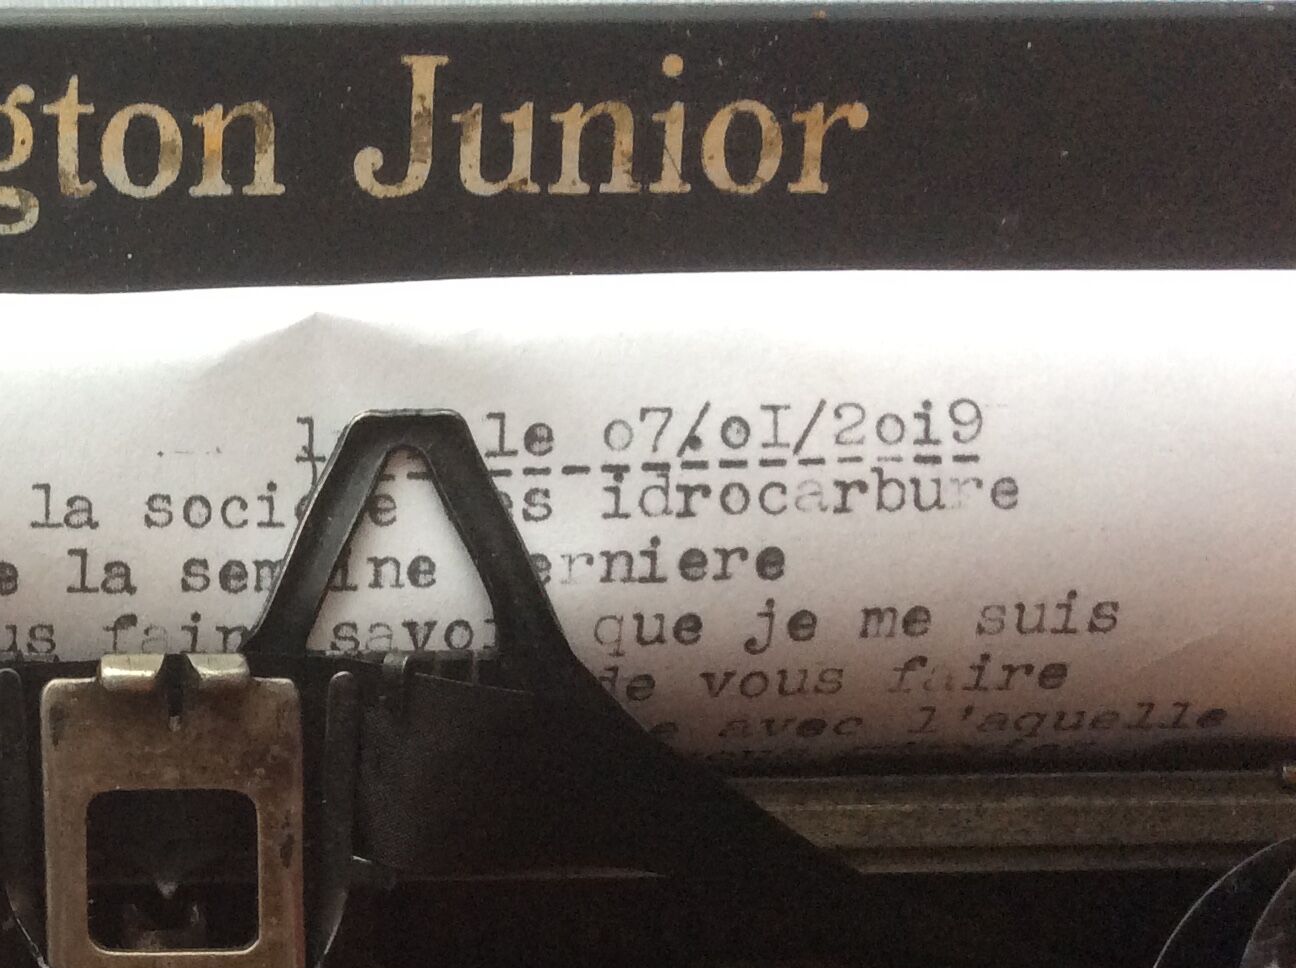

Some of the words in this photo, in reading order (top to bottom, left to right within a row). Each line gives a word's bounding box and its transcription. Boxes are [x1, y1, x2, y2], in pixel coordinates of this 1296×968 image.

[352, 52, 870, 198] Junior
[485, 410, 556, 459] le
[29, 481, 100, 531] la
[600, 466, 1020, 518] idrocarbure
[65, 547, 138, 597] la
[593, 611, 704, 658] que
[743, 597, 818, 656] je
[859, 604, 932, 639] me
[975, 588, 1120, 637] suis
[699, 667, 844, 699] vous
[889, 651, 1070, 693] faire
[718, 716, 863, 737] avec
